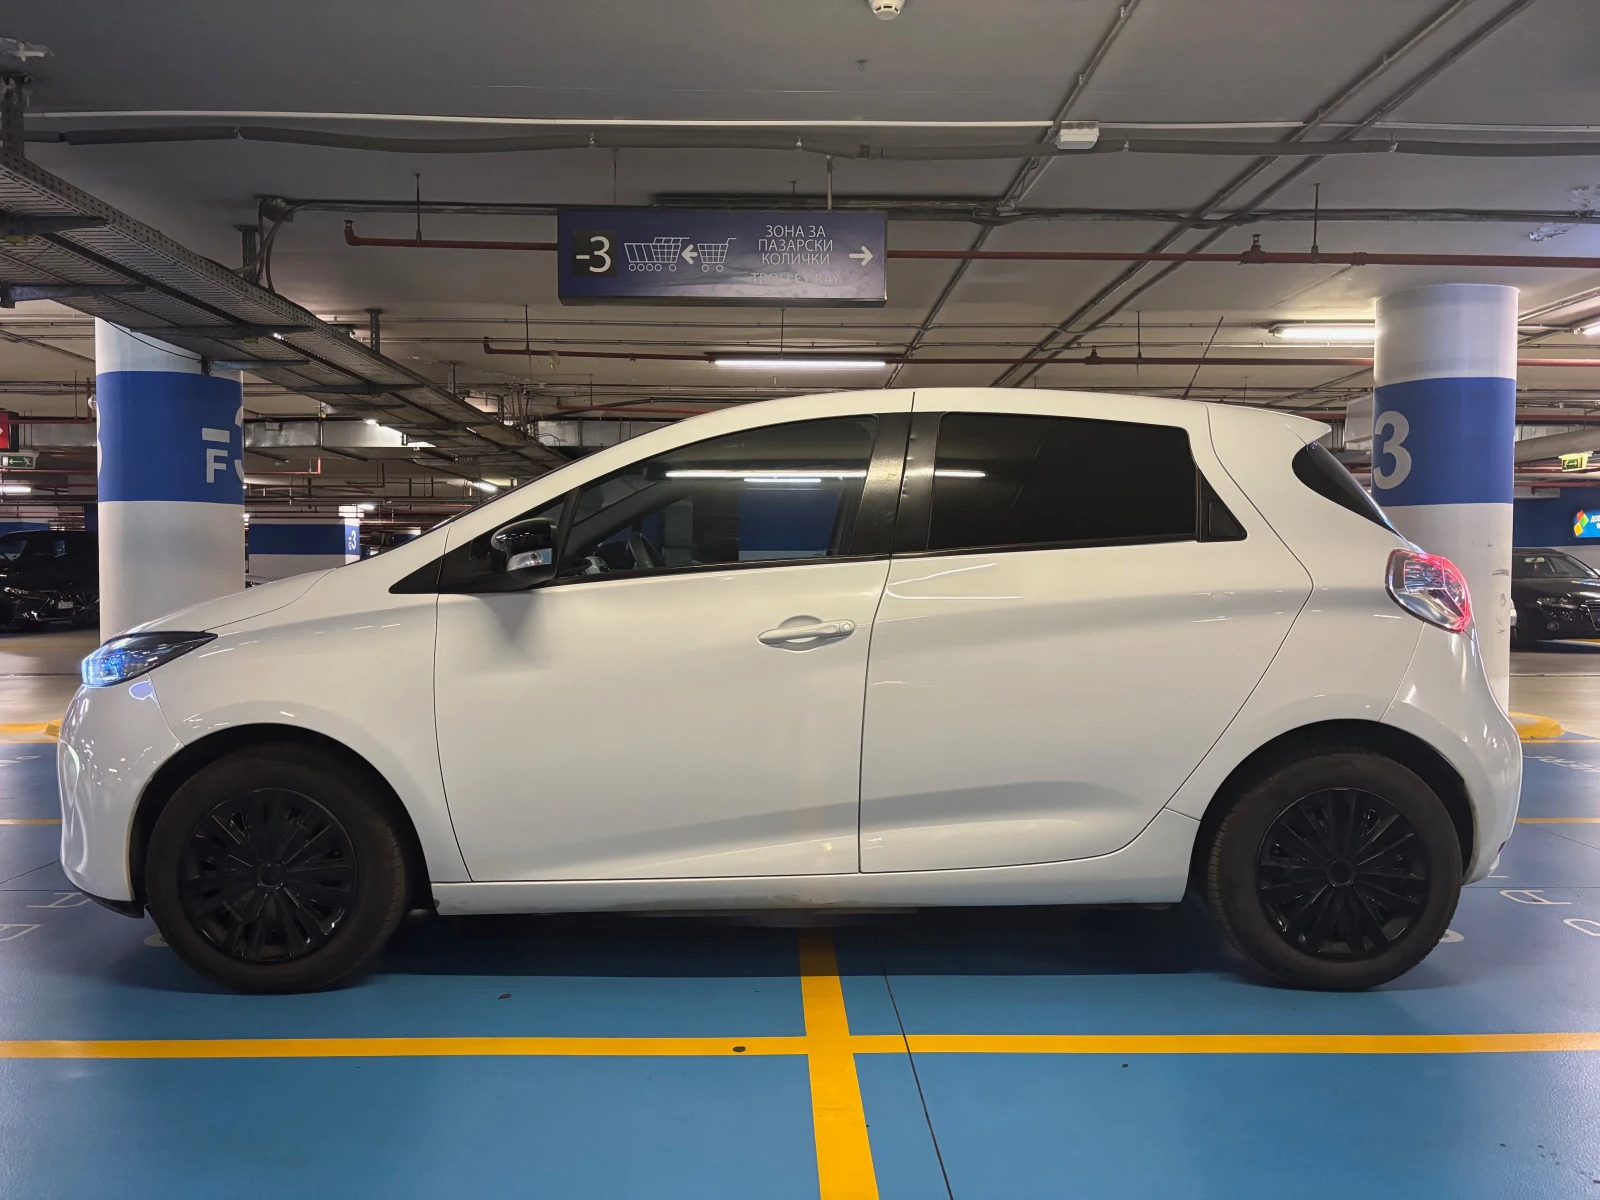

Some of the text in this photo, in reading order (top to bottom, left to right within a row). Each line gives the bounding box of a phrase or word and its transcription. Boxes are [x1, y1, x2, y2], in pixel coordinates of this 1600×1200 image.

[765, 225, 826, 238] ЗОНА ЗА
[758, 239, 833, 252] ПАЗАРСКИ
[575, 235, 612, 273] -3
[761, 253, 830, 266] КОЛИЧКИ
[750, 272, 810, 285] TROLLEY
[1373, 410, 1412, 490] 3
